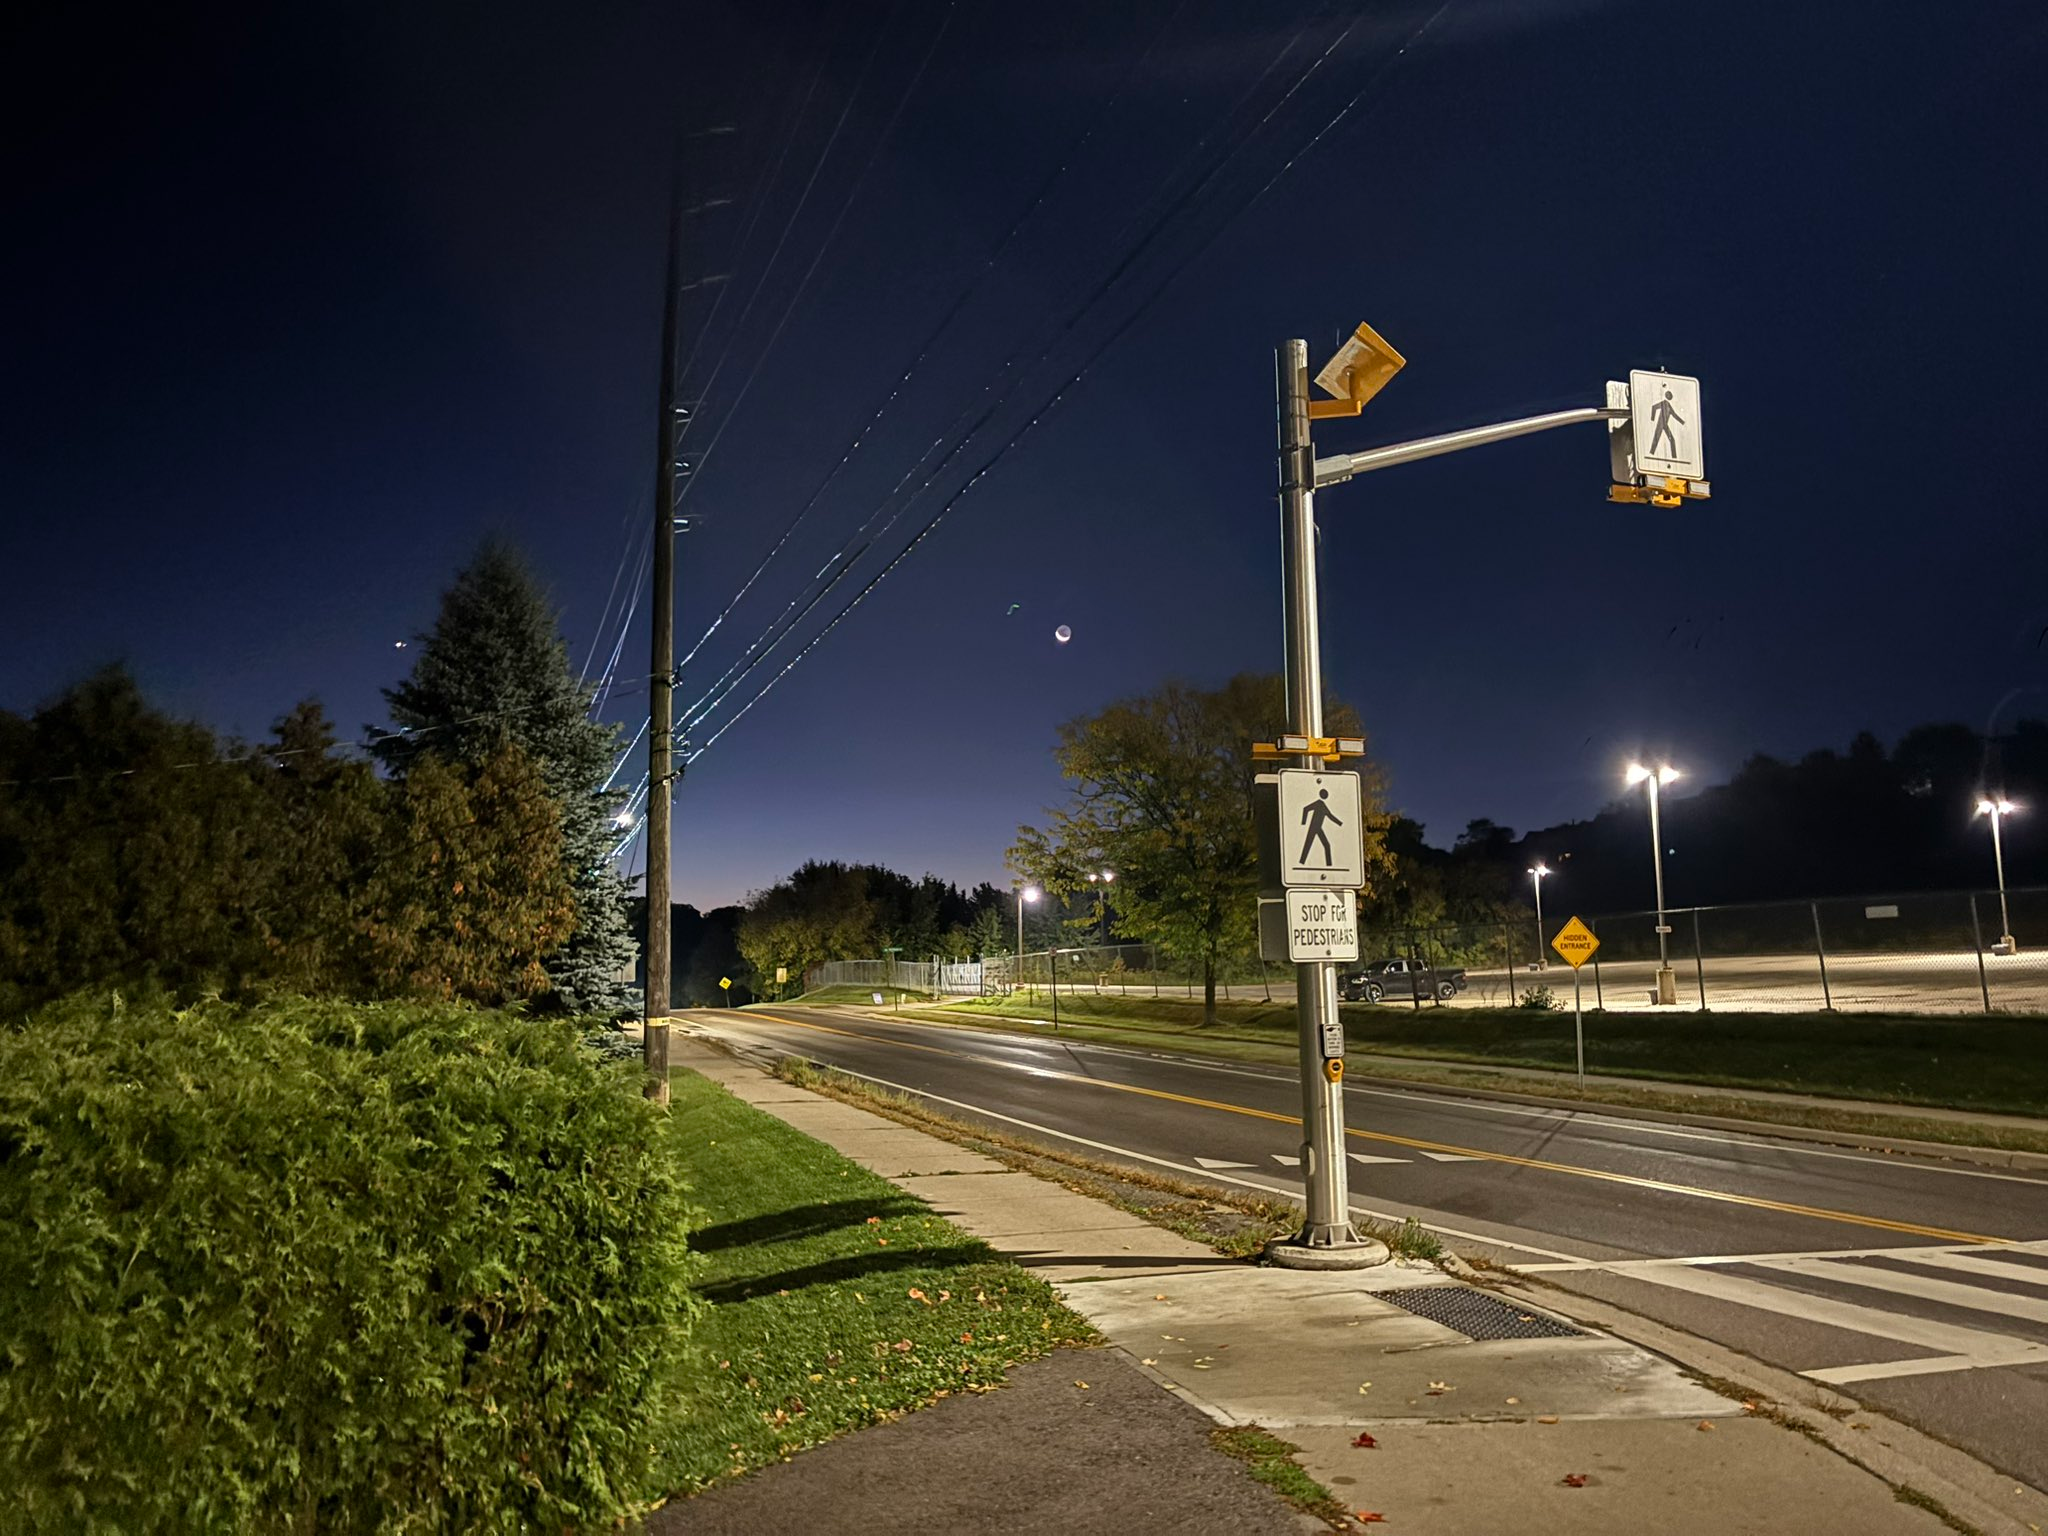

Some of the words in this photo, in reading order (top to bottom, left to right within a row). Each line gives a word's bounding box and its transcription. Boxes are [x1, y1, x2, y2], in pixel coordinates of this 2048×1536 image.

[1301, 904, 1327, 922] STOP
[1331, 904, 1347, 922] FOR
[1294, 928, 1354, 946] PEDESTRIANS
